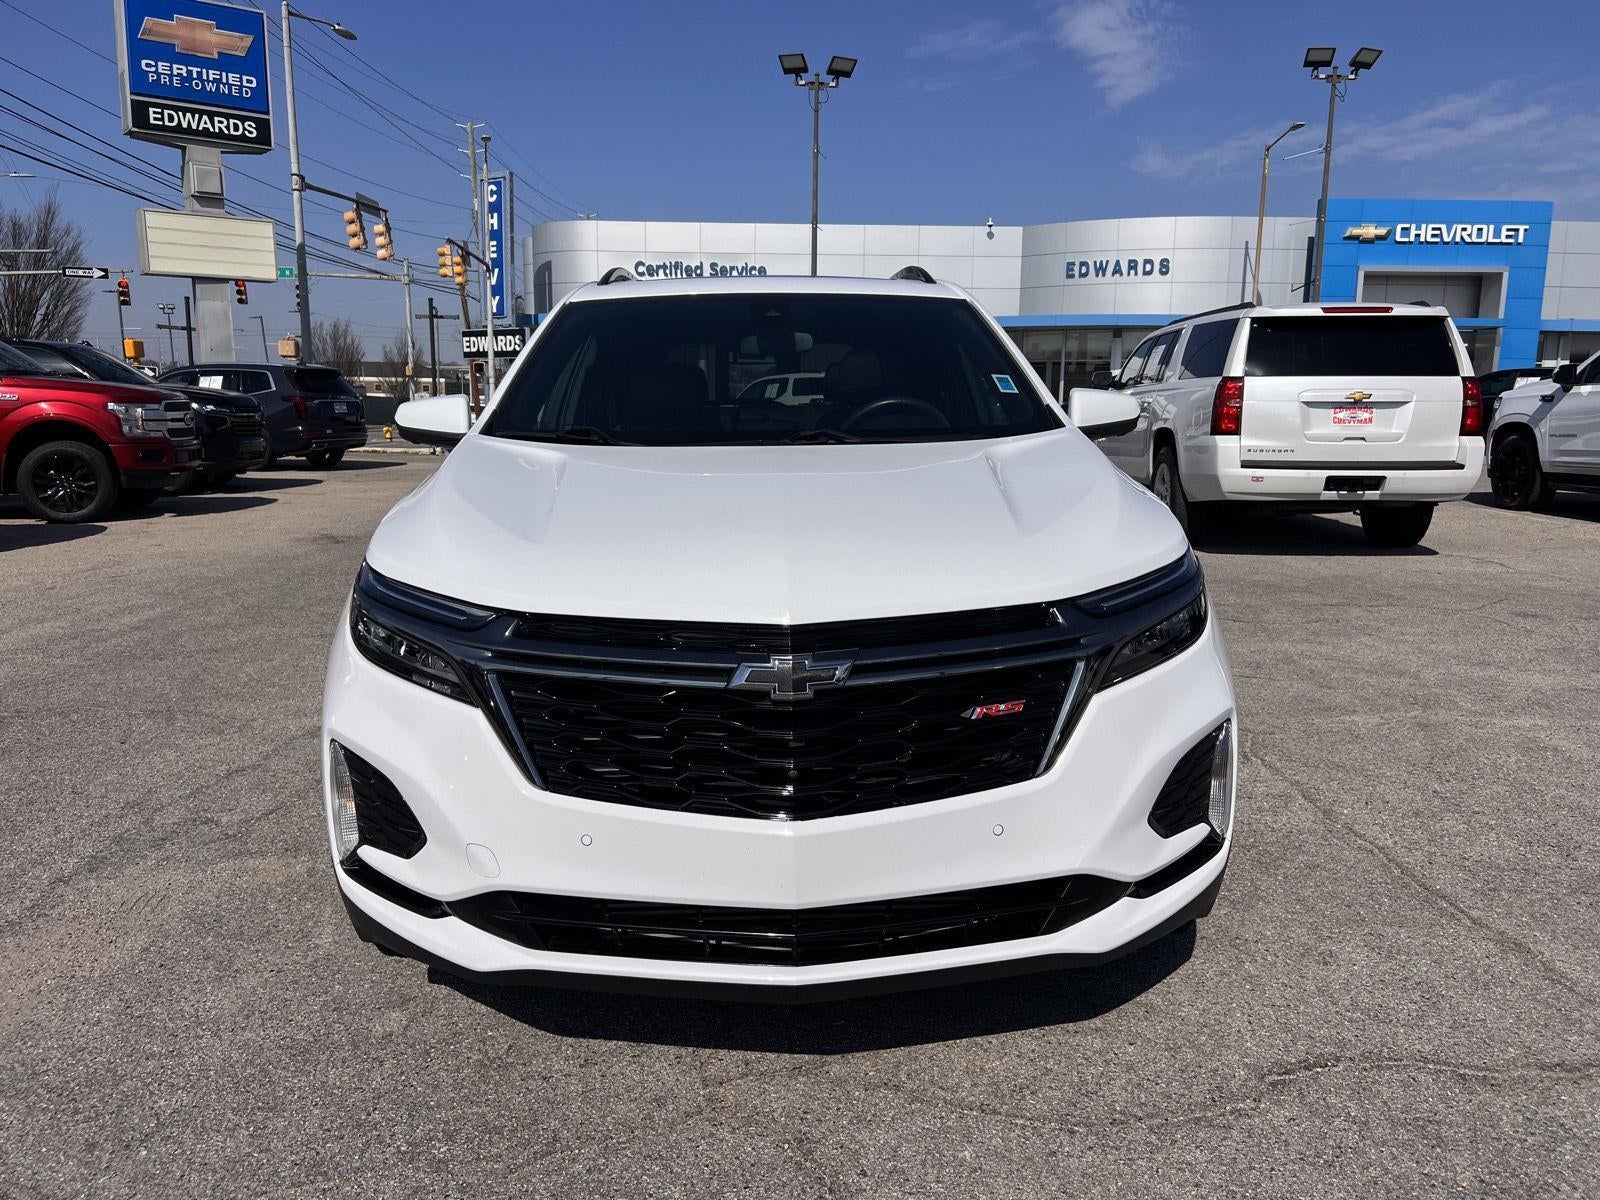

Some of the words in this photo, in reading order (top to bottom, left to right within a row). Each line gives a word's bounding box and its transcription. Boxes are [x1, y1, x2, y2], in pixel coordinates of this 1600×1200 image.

[141, 59, 257, 88] CERTIFIED
[148, 73, 252, 98] PRE-OWNED
[148, 107, 258, 138] EDWARDS
[1395, 223, 1530, 245] CHEVROLET
[487, 184, 499, 313] CHEVY
[634, 260, 704, 278] Certified
[709, 261, 768, 277] Service
[1065, 258, 1171, 279] EDWARDS
[462, 334, 524, 353] EDWARDS
[1332, 415, 1373, 425] CHEVYMAN
[1333, 406, 1374, 415] EDWARDS
[976, 700, 1025, 719] RS
